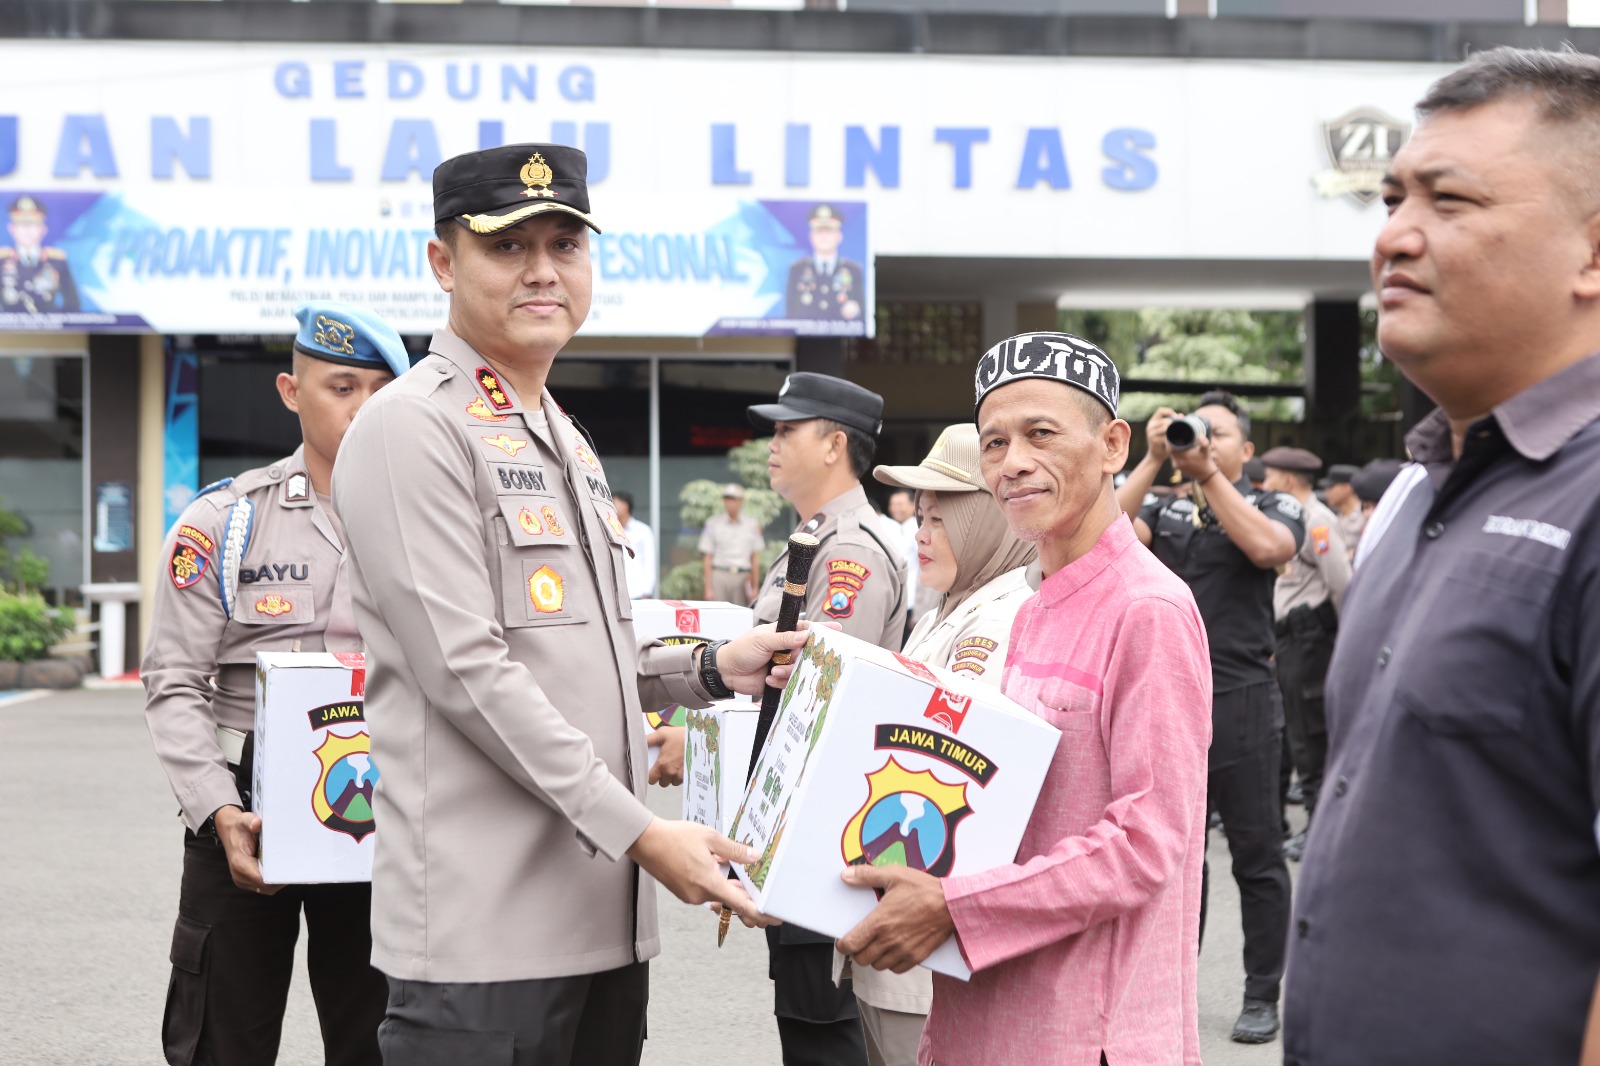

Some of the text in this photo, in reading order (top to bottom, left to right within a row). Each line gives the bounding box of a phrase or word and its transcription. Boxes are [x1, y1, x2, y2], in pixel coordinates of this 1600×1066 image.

[274, 60, 597, 103] GEDUNG
[710, 121, 1160, 191] LINTAS
[109, 227, 293, 285] PROAKTIF,
[303, 228, 437, 279] INOVAT
[497, 467, 546, 491] BOBBY
[181, 526, 212, 550] PROPAM
[239, 563, 309, 583] BAYU
[959, 637, 994, 649] POLRES
[321, 705, 360, 721] JAWA
[889, 727, 988, 776] JAWA TIMUR
